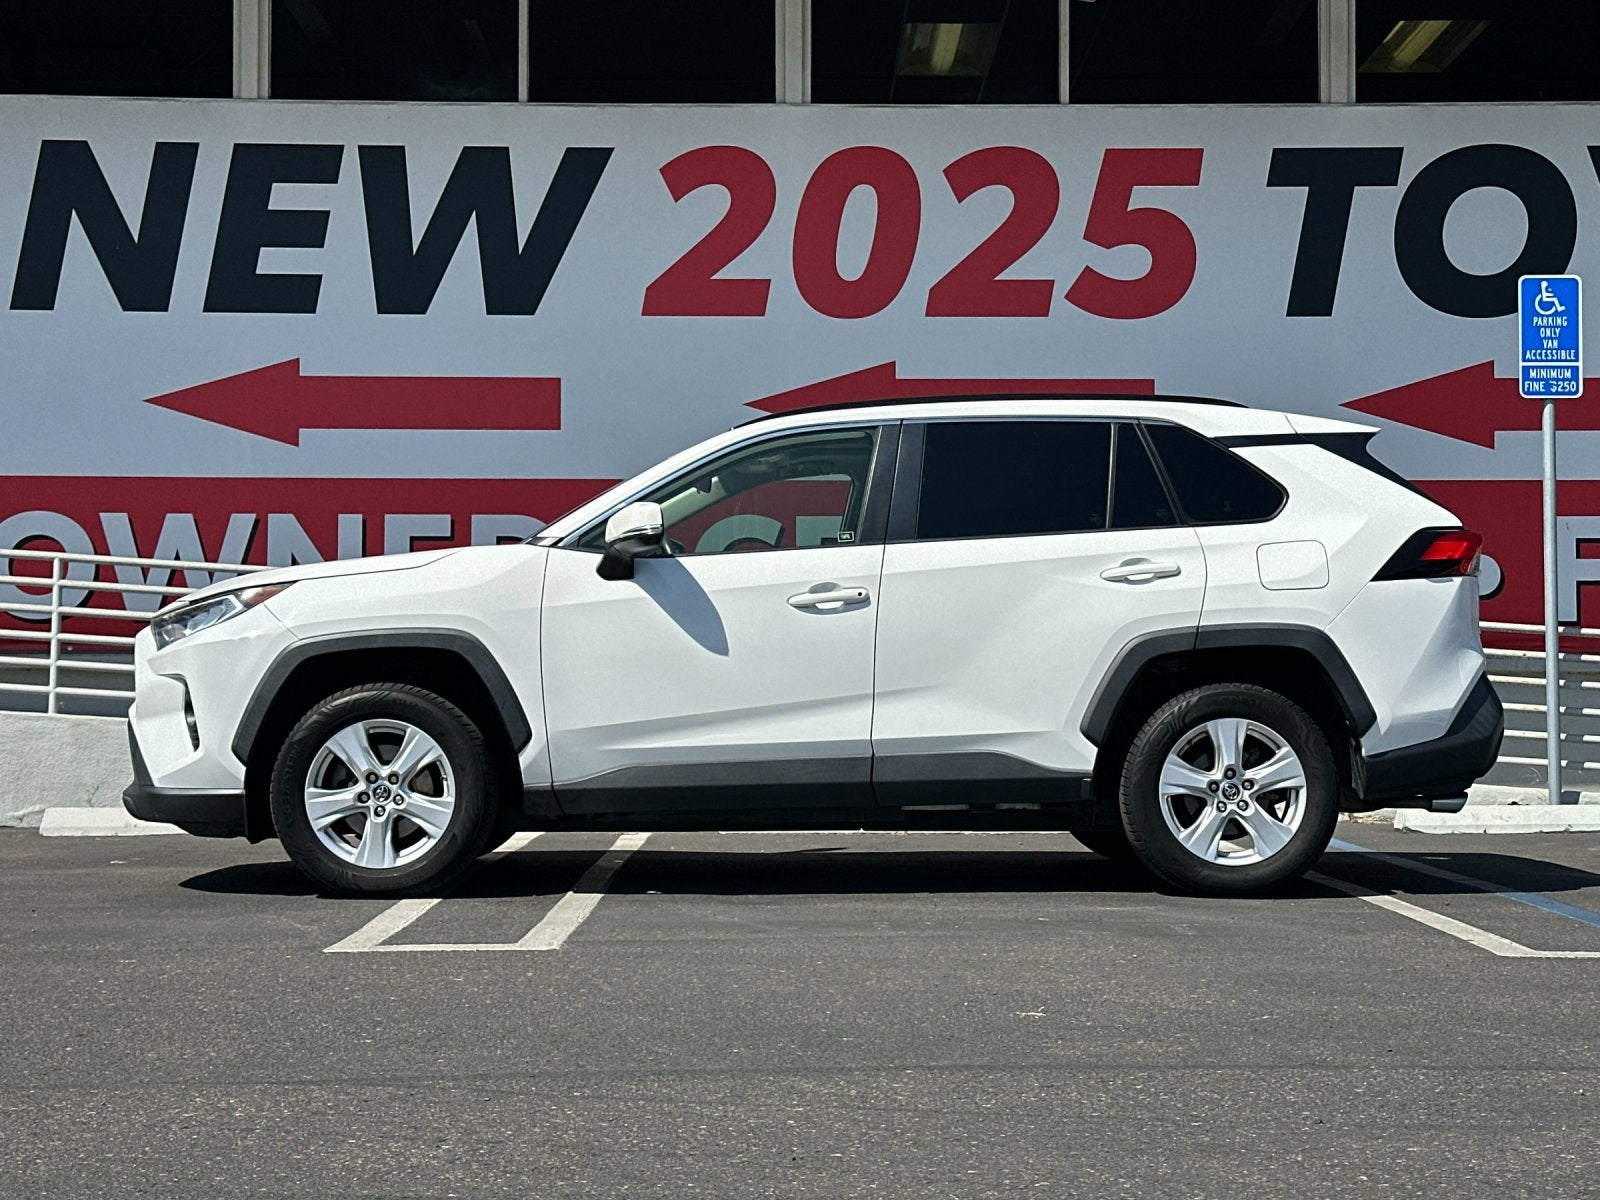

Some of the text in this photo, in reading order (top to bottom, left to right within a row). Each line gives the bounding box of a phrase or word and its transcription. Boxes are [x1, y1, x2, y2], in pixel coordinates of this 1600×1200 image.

[10, 139, 1600, 319] NEW 2025 TO
[1533, 316, 1568, 327] PARKING
[1540, 327, 1561, 338] ONLY
[1542, 339, 1559, 349] VAN
[1525, 350, 1576, 360] ACCESSIBLE
[1529, 368, 1572, 379] MINIMUM
[1524, 381, 1546, 392] FINE
